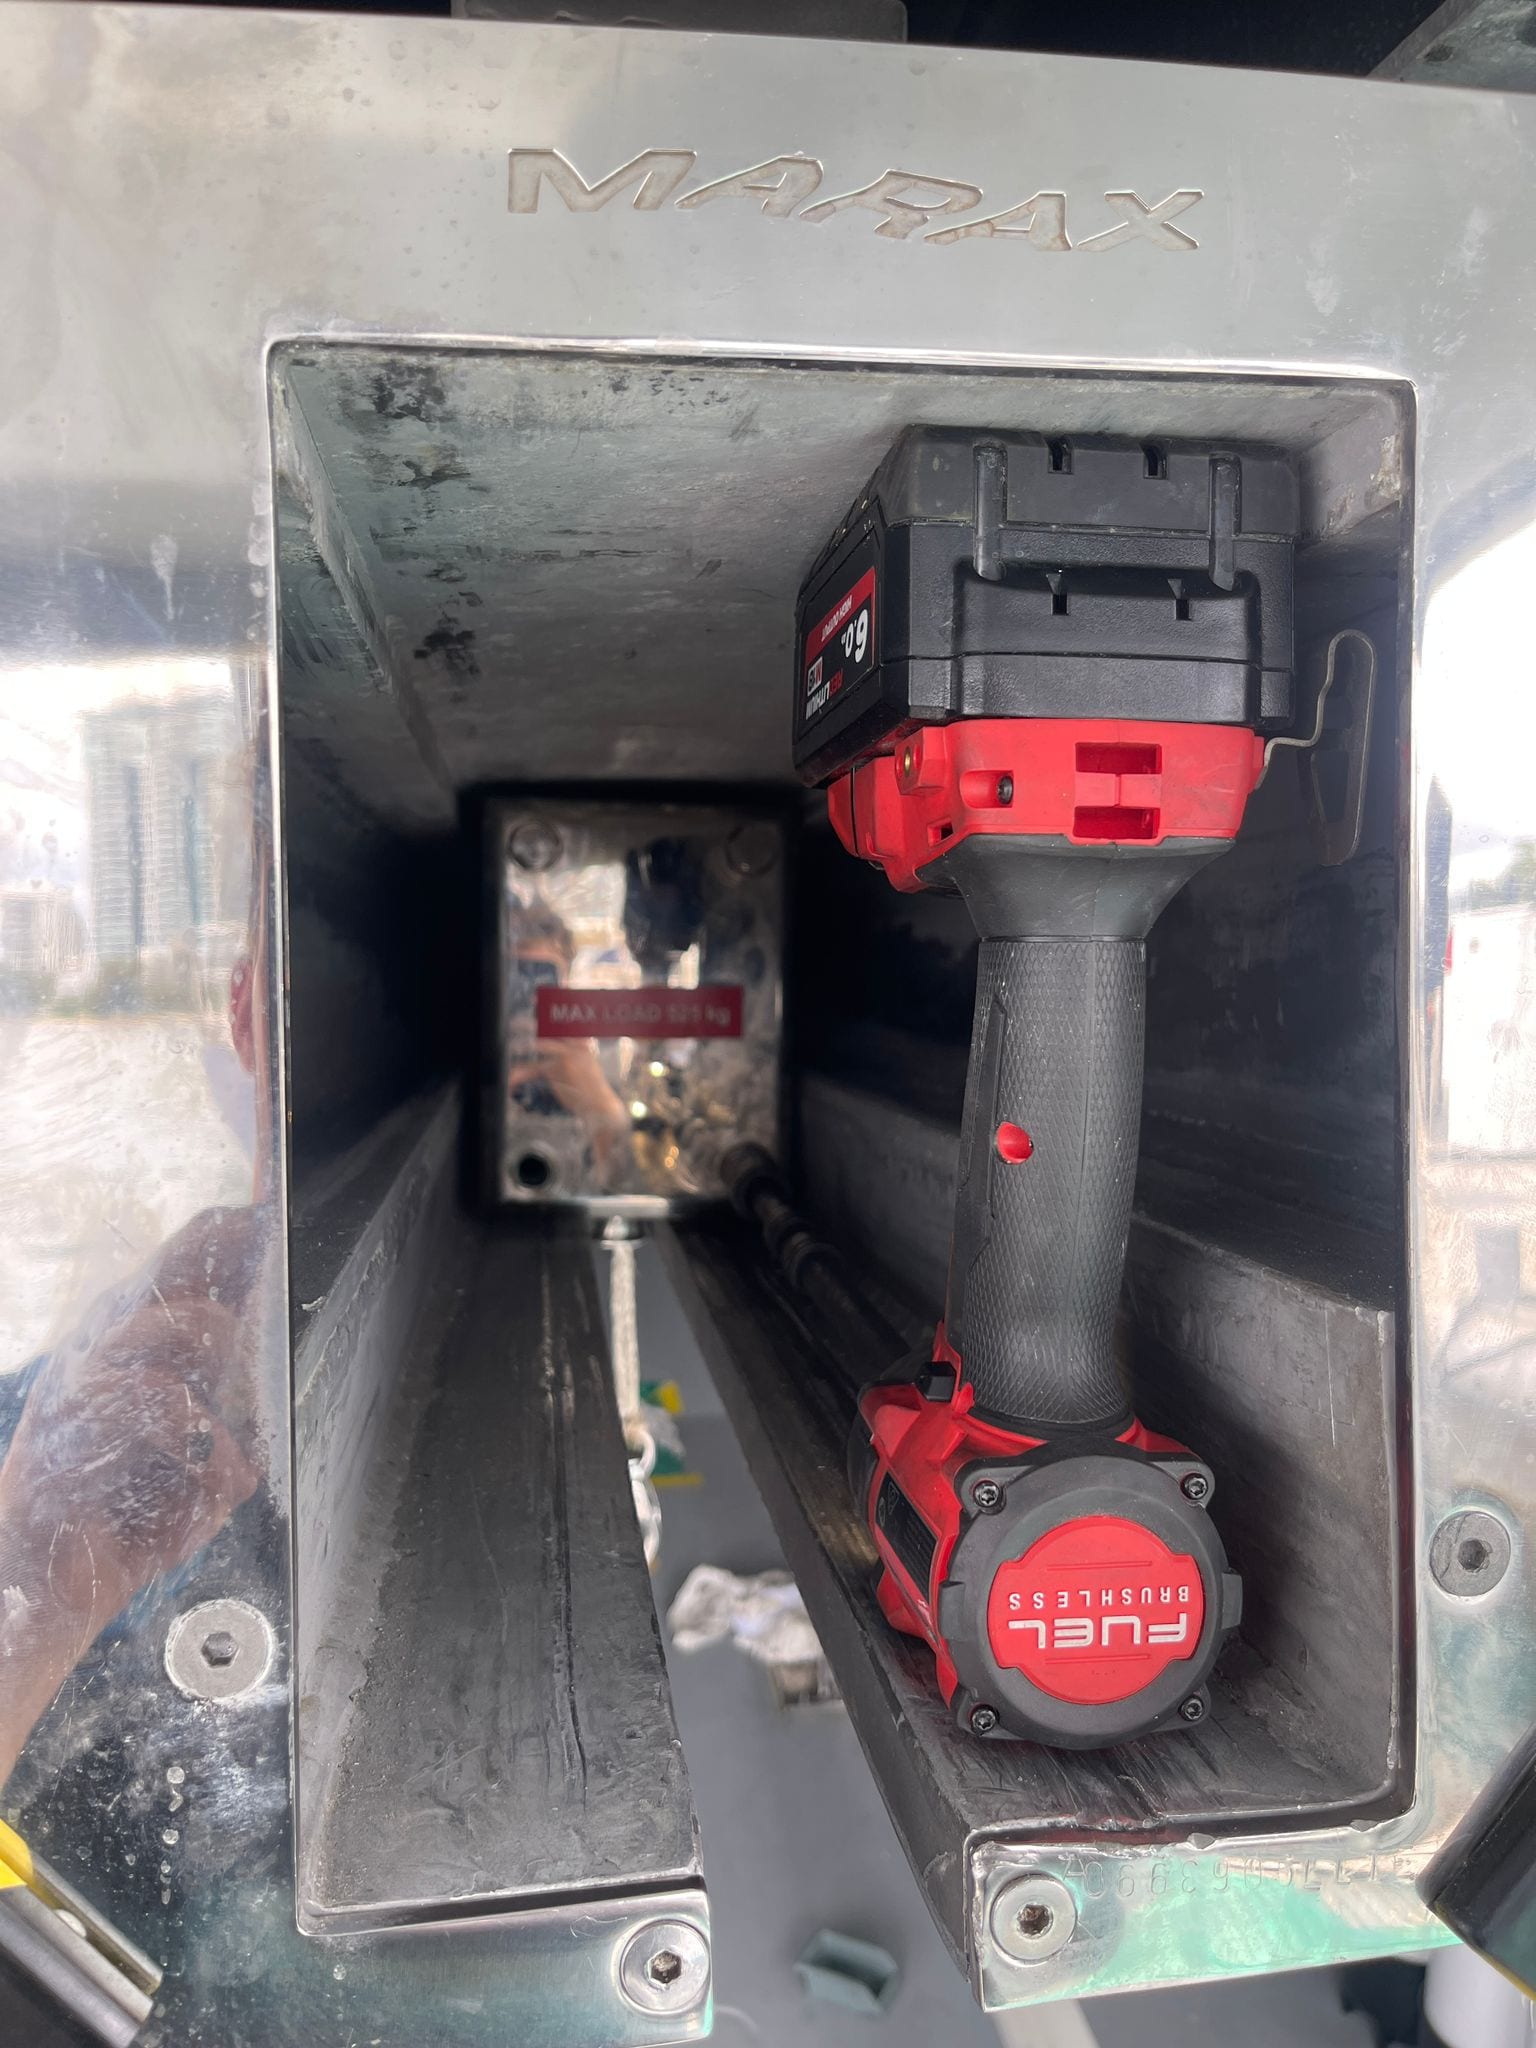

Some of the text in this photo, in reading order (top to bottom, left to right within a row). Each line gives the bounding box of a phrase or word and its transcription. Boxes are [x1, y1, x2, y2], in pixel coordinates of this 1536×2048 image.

[507, 147, 1205, 252] MARAX
[551, 1003, 597, 1023] MAX
[602, 1003, 662, 1023] LOAD
[1008, 1587, 1189, 1610] BRUSHLESS
[1008, 1612, 1188, 1648] FUEL
